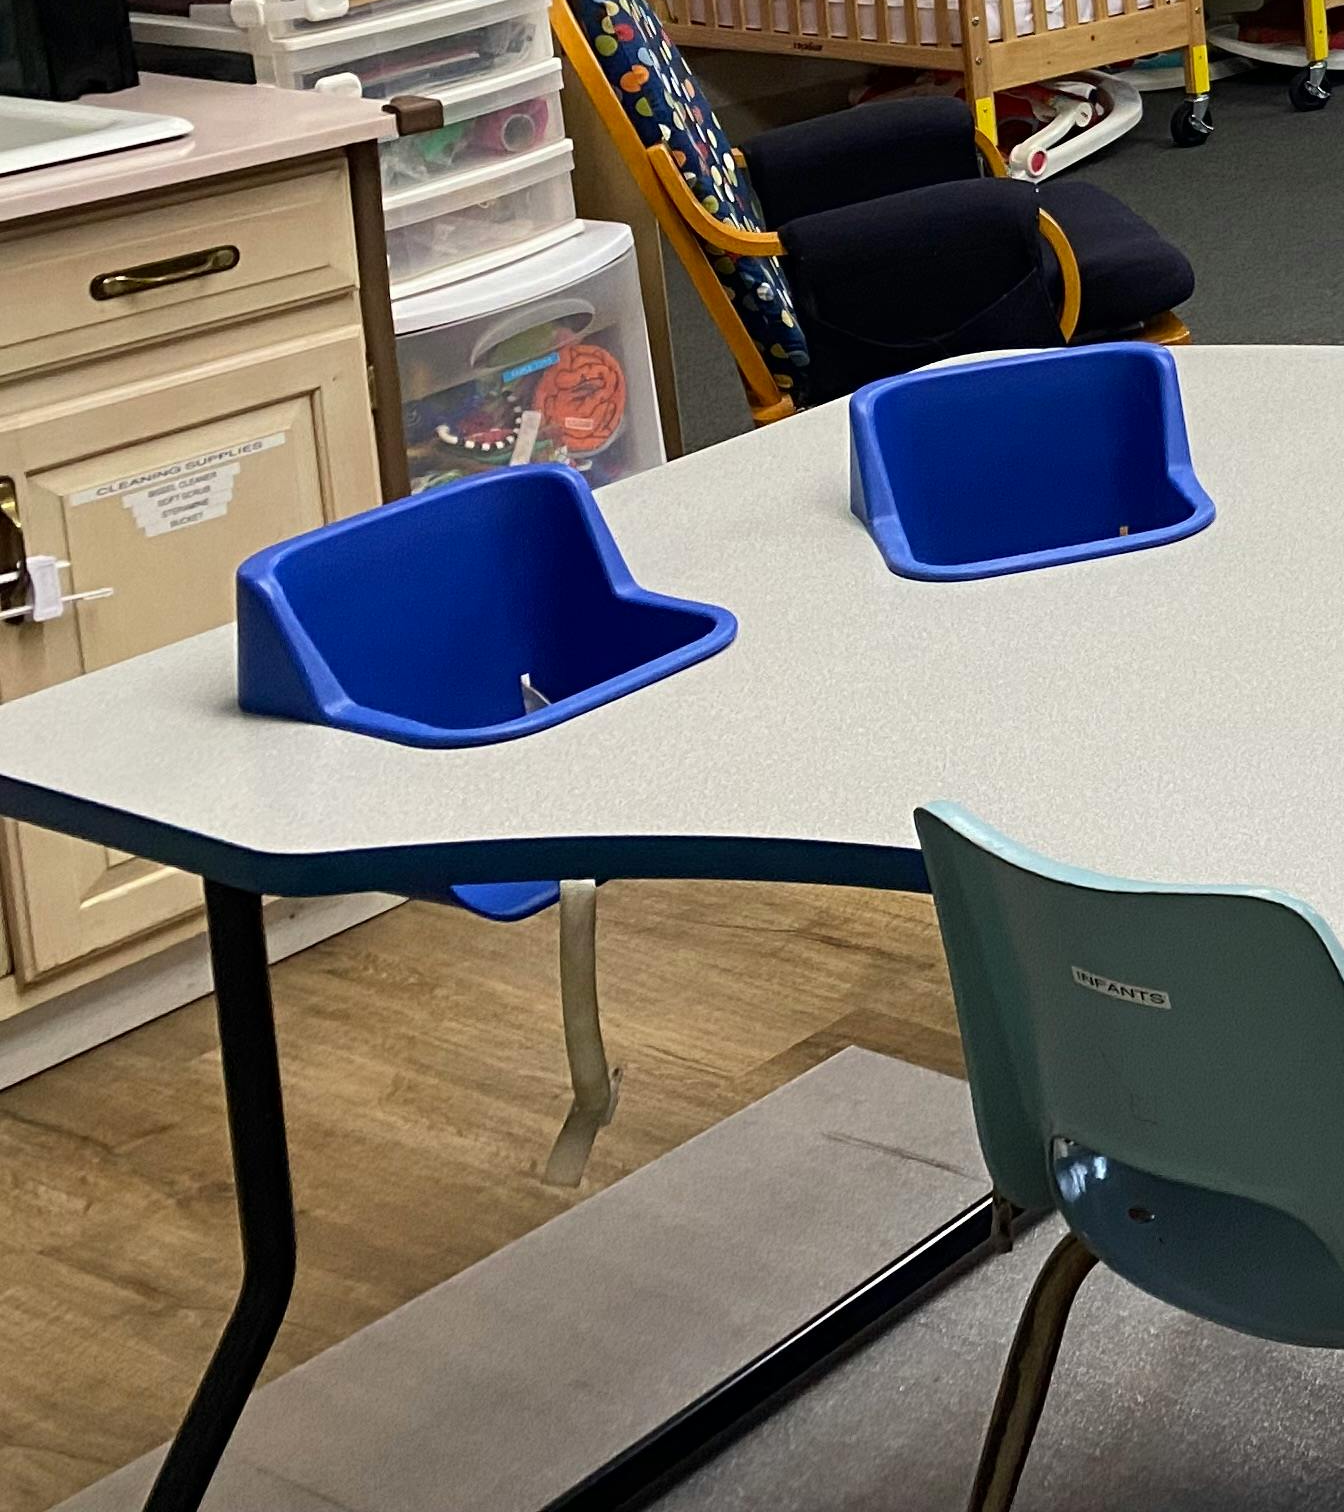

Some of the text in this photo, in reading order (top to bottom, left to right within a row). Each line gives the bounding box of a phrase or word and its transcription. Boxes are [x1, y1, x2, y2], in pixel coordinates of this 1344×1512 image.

[96, 441, 263, 496] CLEANING SUPPLIES
[178, 471, 217, 489] CLEANER
[157, 485, 211, 508] SOFT SCRUB
[170, 512, 204, 529] BUCKET
[1076, 970, 1166, 1005] INFANTS
